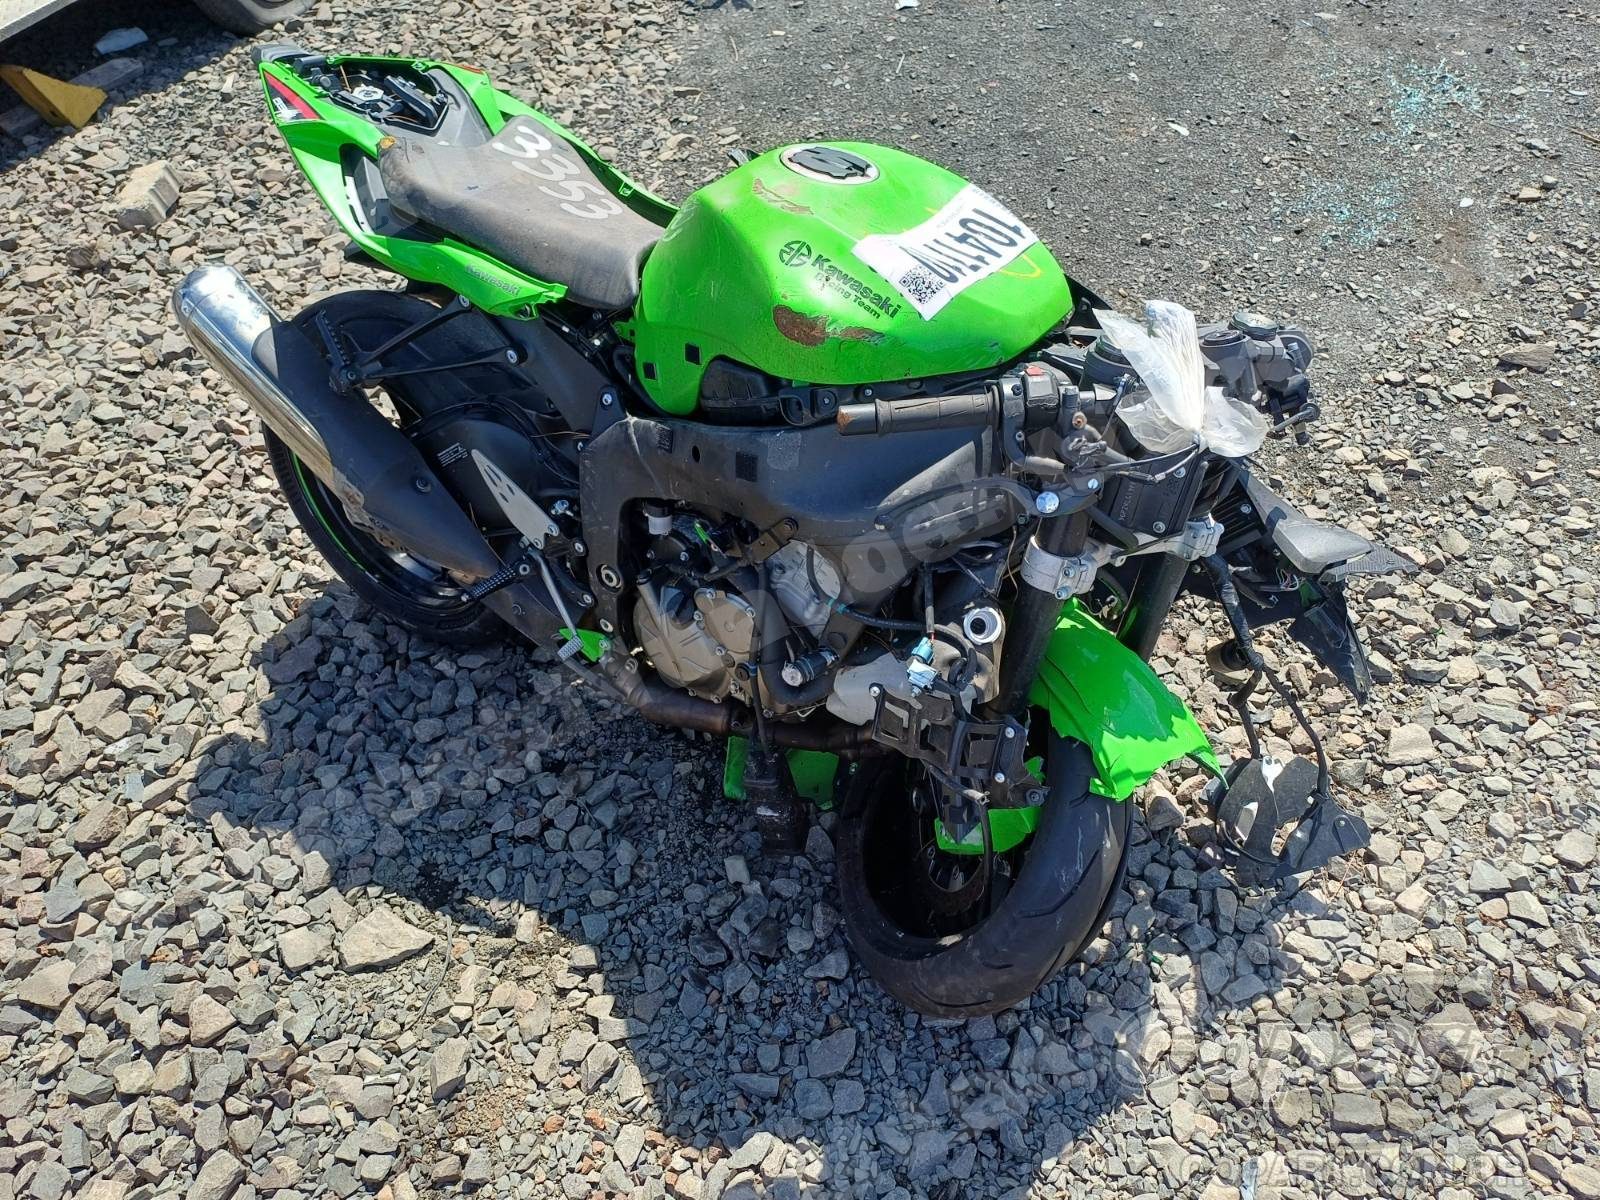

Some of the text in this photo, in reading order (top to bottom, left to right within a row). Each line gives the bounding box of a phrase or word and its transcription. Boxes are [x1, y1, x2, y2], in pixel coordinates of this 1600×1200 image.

[492, 125, 623, 219] 3353
[465, 263, 521, 297] Kawasaki
[811, 254, 902, 318] Kawasaki
[853, 295, 881, 319] Team
